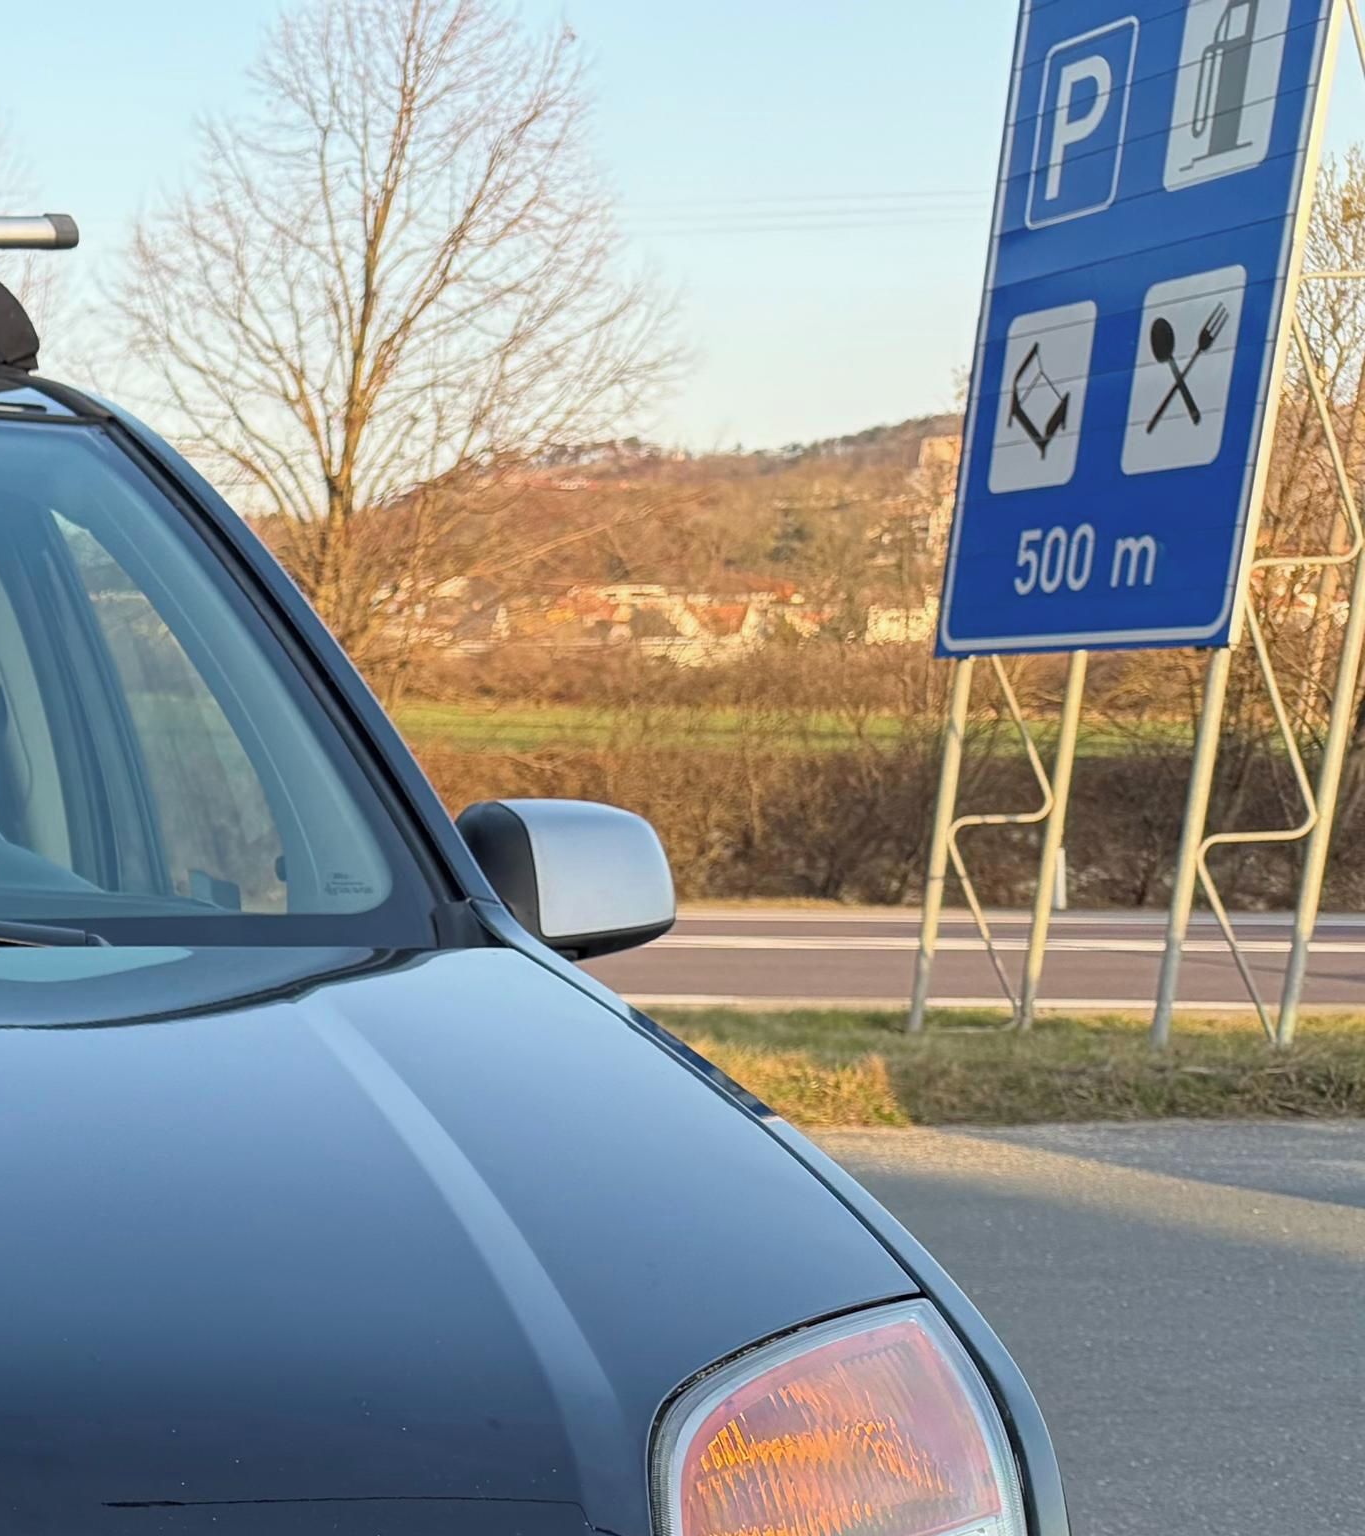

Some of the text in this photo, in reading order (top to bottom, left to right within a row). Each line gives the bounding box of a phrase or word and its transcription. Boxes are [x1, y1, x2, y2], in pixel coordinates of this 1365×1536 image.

[1045, 55, 1113, 201] P
[1014, 523, 1157, 595] 500 m
